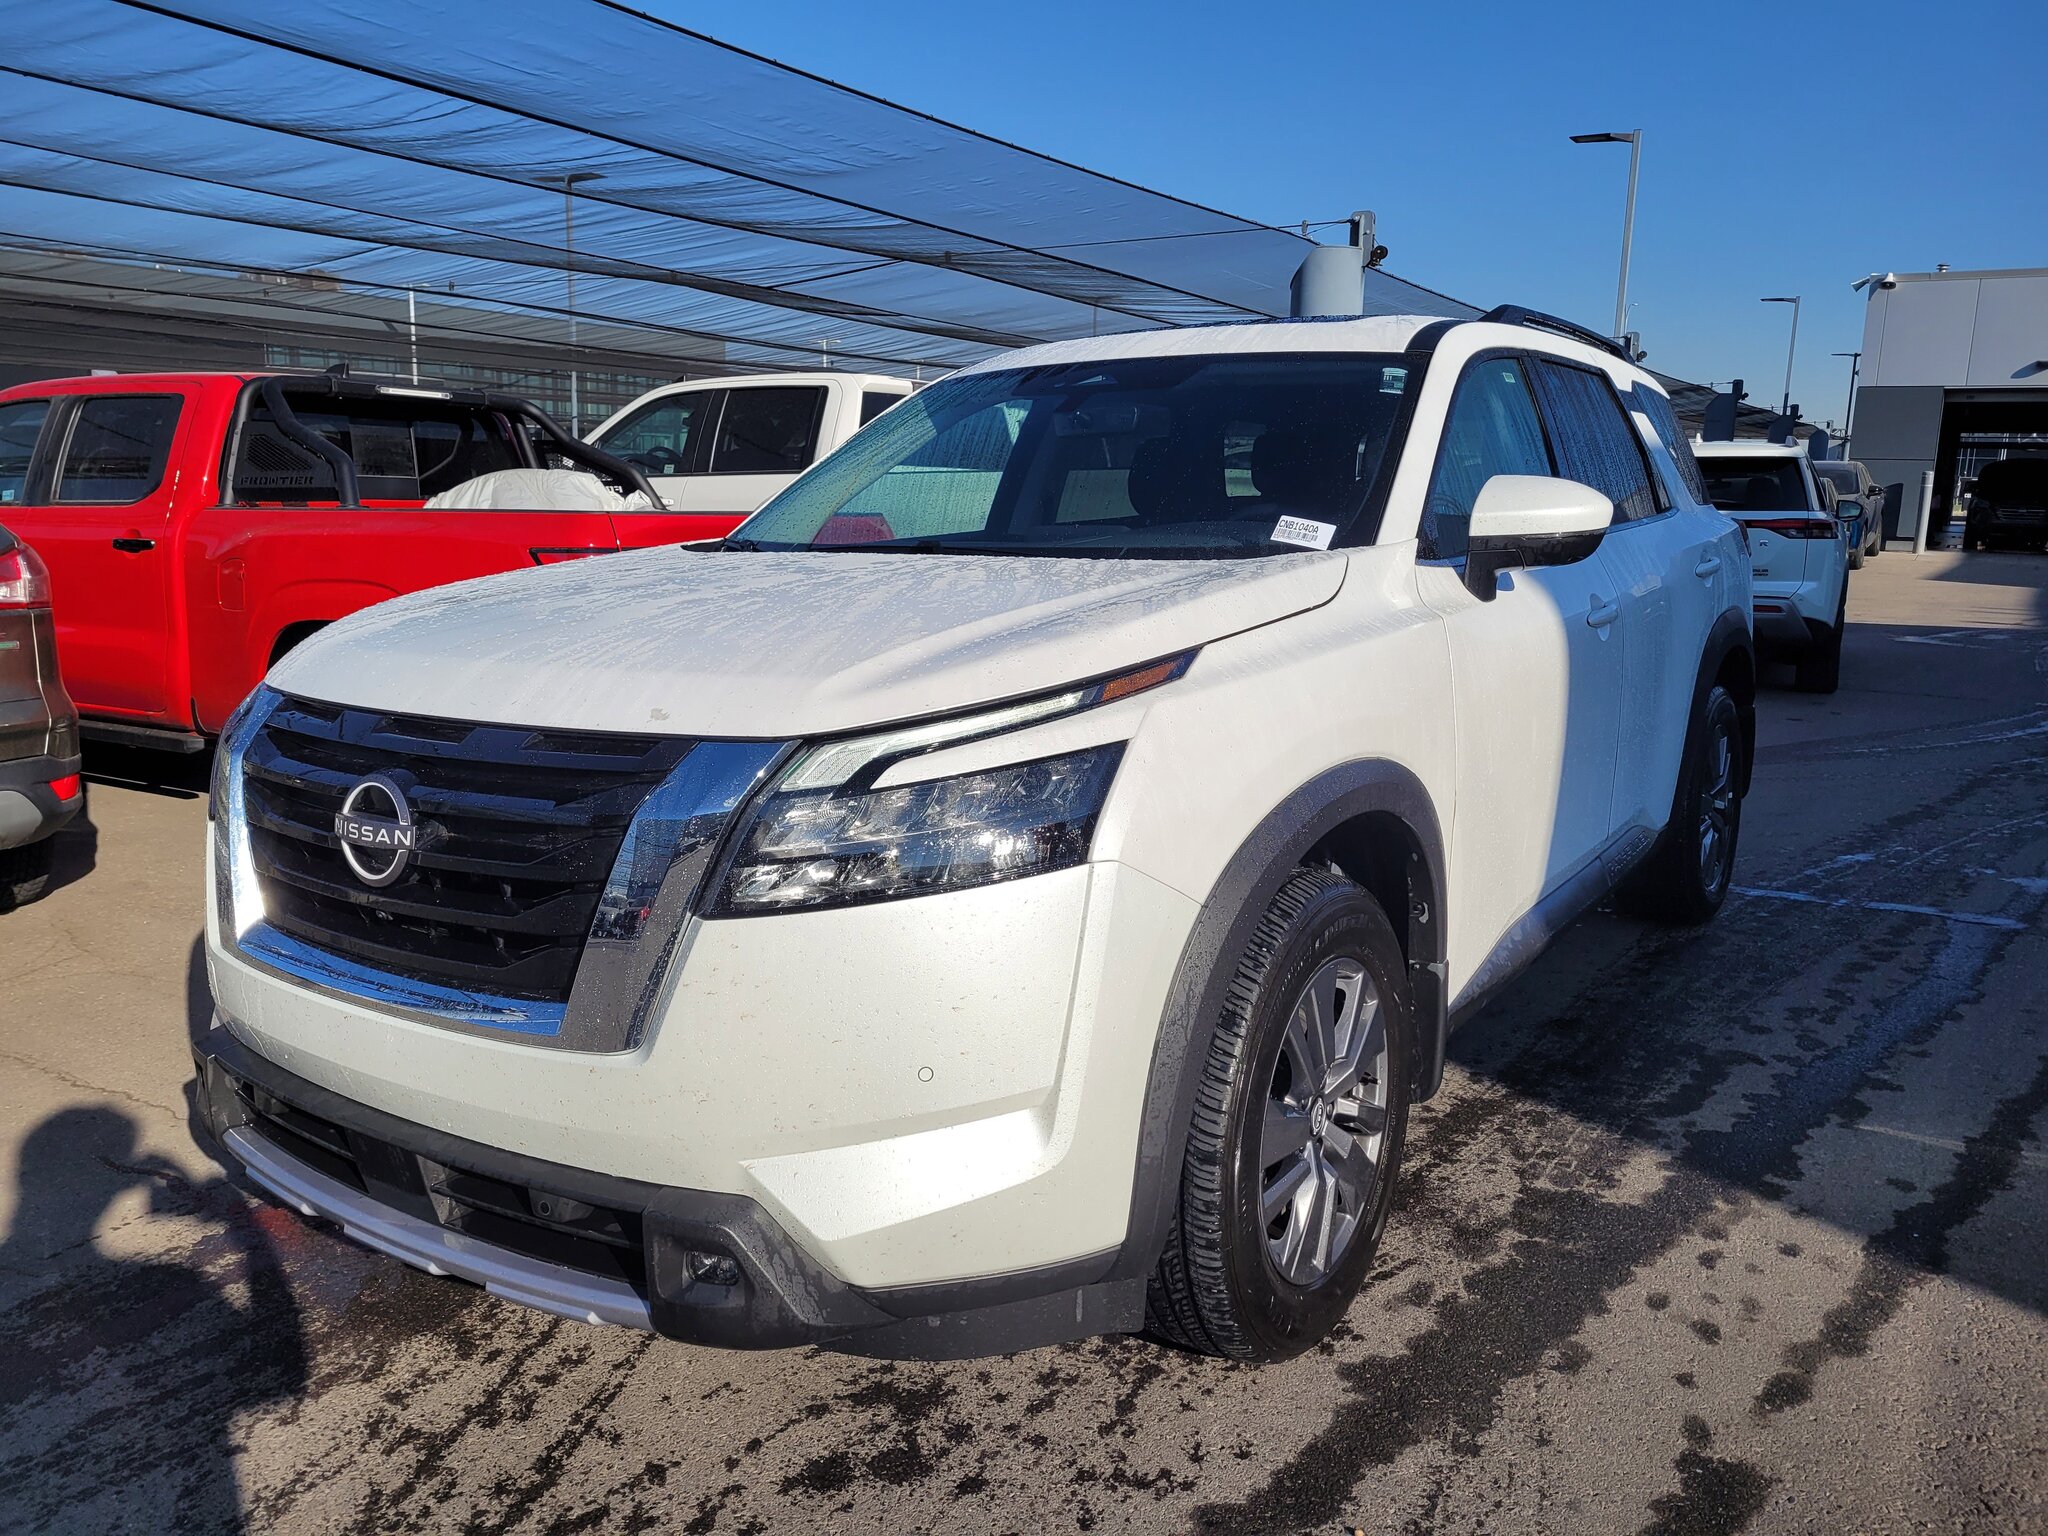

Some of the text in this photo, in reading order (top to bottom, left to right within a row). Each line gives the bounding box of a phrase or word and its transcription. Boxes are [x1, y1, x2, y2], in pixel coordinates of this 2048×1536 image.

[240, 476, 314, 486] FRONTIER
[1278, 519, 1319, 534] CNB1040A
[335, 817, 411, 846] NISSAN
